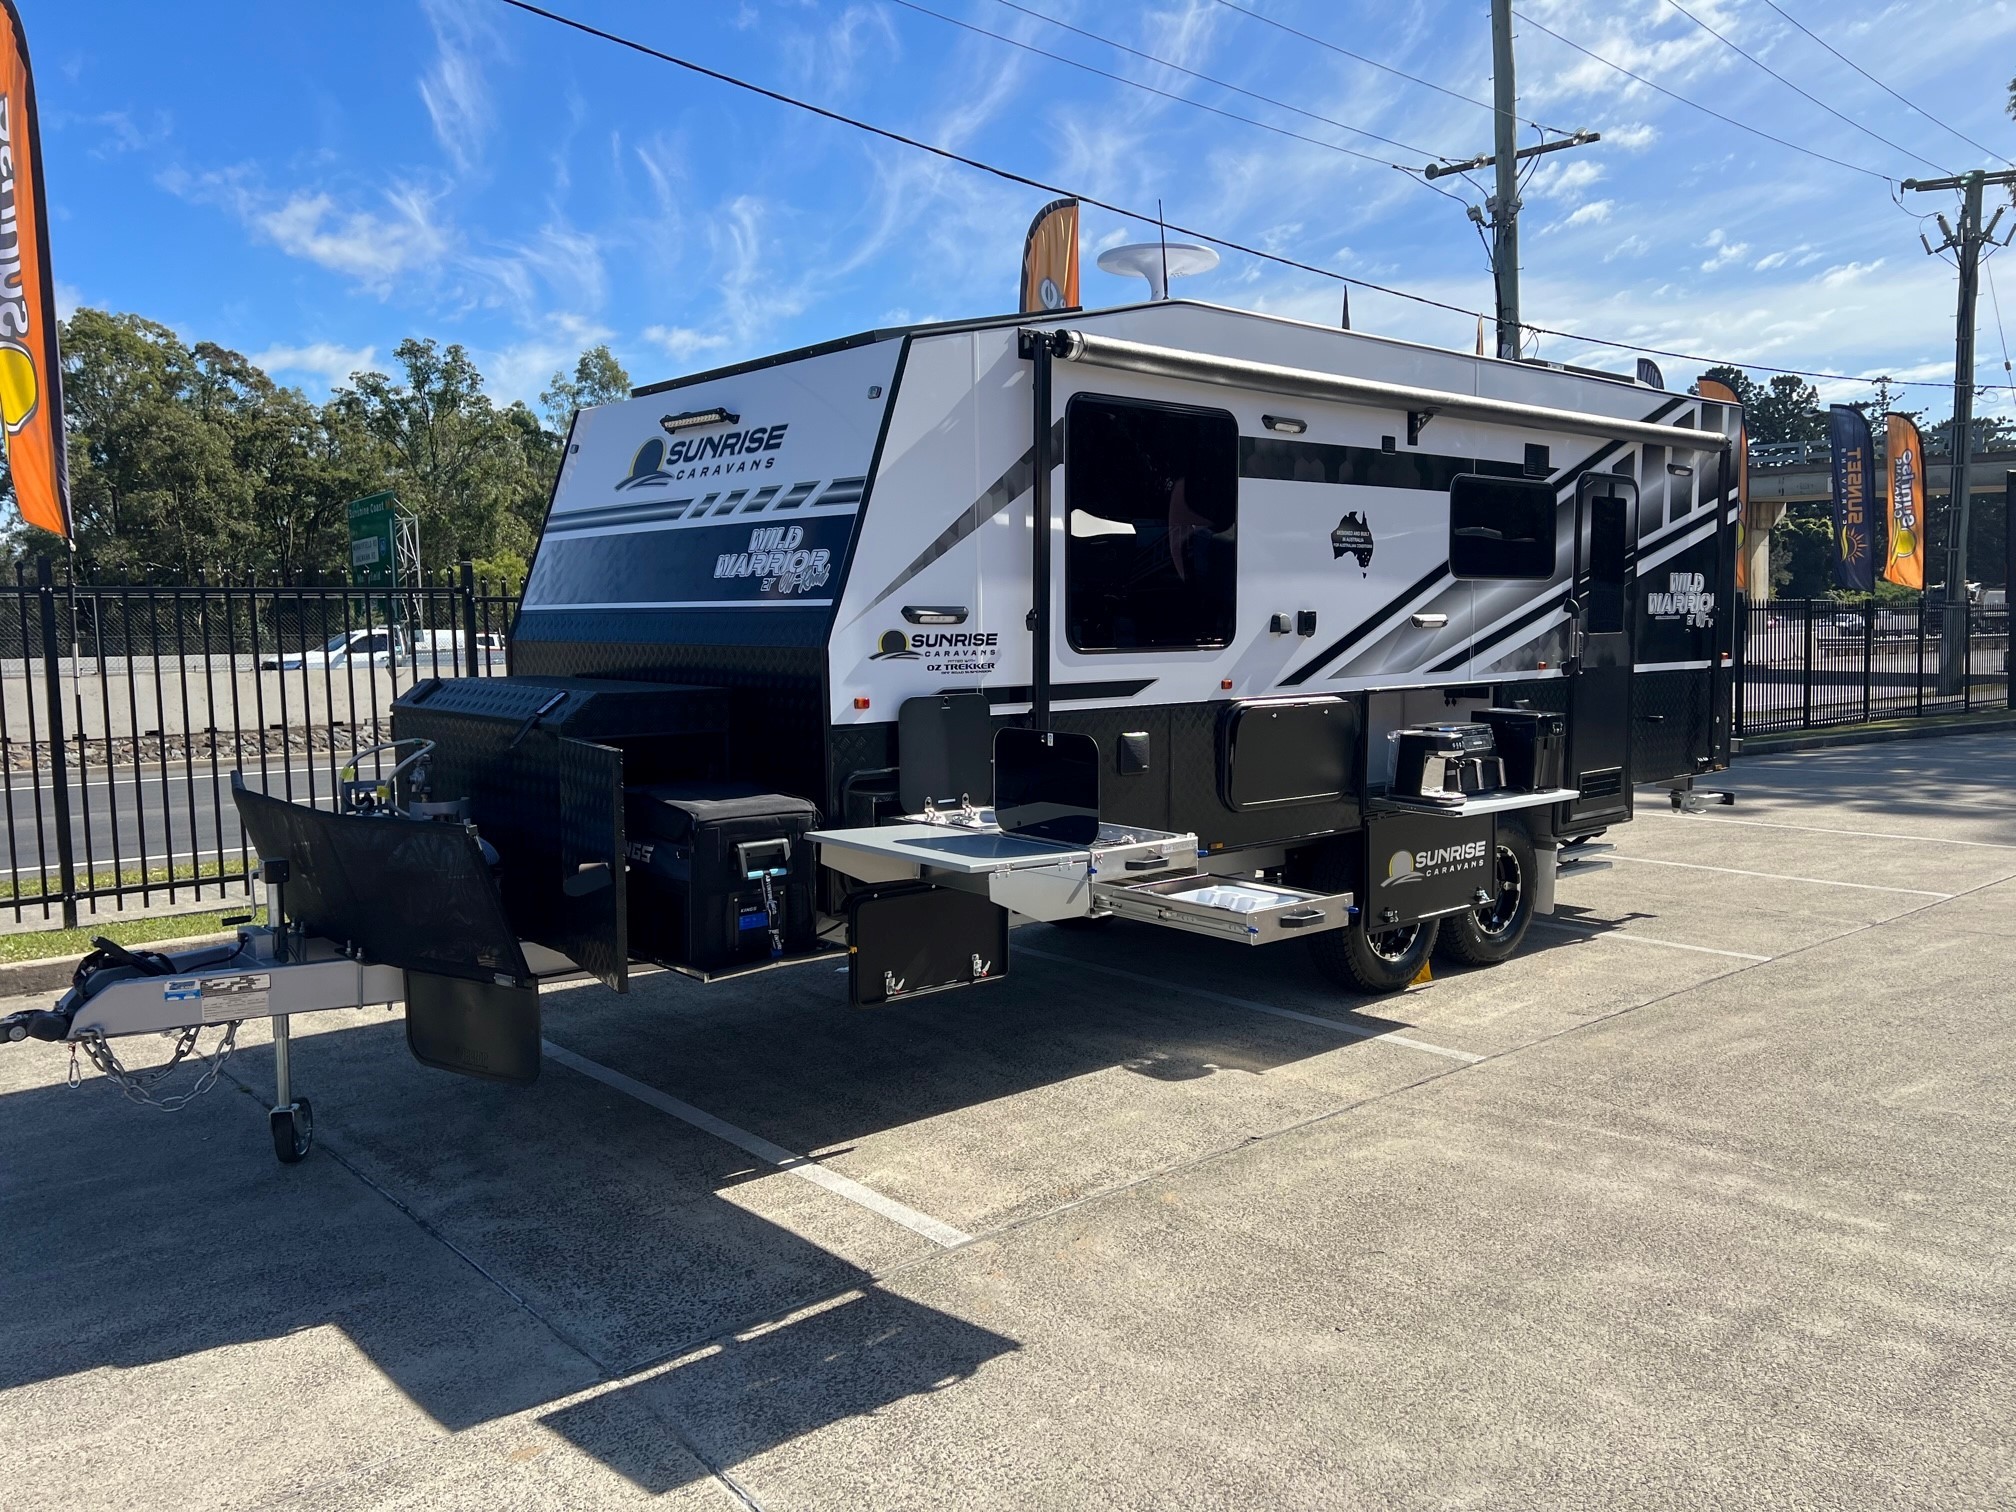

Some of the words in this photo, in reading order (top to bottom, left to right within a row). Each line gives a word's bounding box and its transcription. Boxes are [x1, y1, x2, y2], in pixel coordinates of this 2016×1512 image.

[666, 423, 789, 465] SUNRISE
[676, 457, 775, 480] CARAVANS
[370, 500, 384, 513] Coast
[748, 525, 804, 553] WILD
[713, 549, 830, 579] WARRIOR
[1669, 572, 1705, 594] WILD
[911, 633, 998, 648] SUNRISE
[925, 649, 996, 657] CARAVANS
[927, 664, 942, 672] OZ
[625, 841, 654, 863] NGS
[1415, 841, 1486, 869] SUNRISE
[1426, 859, 1484, 877] CARAVANS
